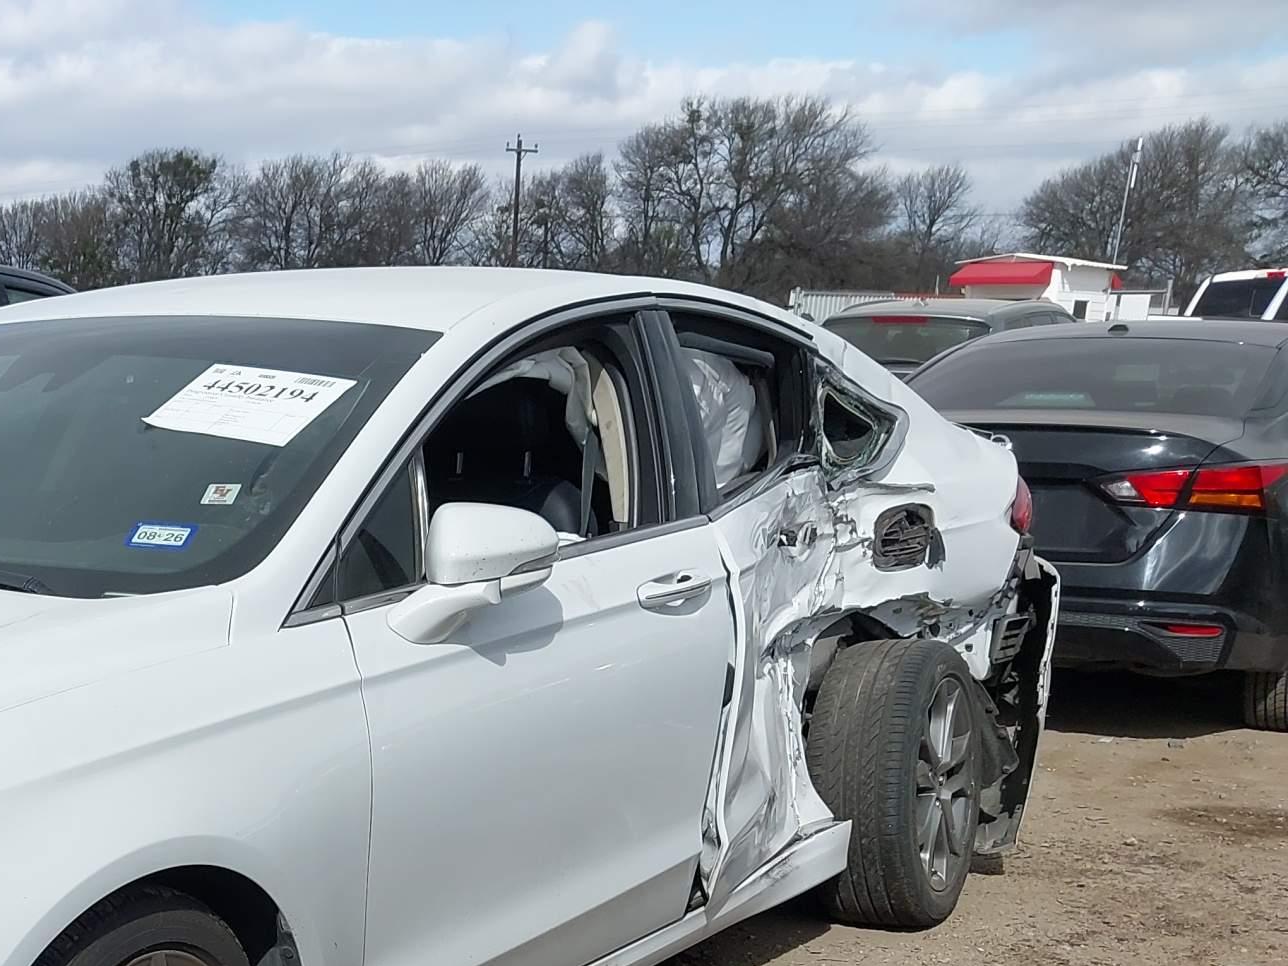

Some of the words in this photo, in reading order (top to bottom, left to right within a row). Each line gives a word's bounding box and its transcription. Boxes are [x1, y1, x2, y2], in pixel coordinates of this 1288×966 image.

[203, 379, 319, 403] 44502194
[137, 530, 158, 541] 08
[162, 532, 185, 543] 26
